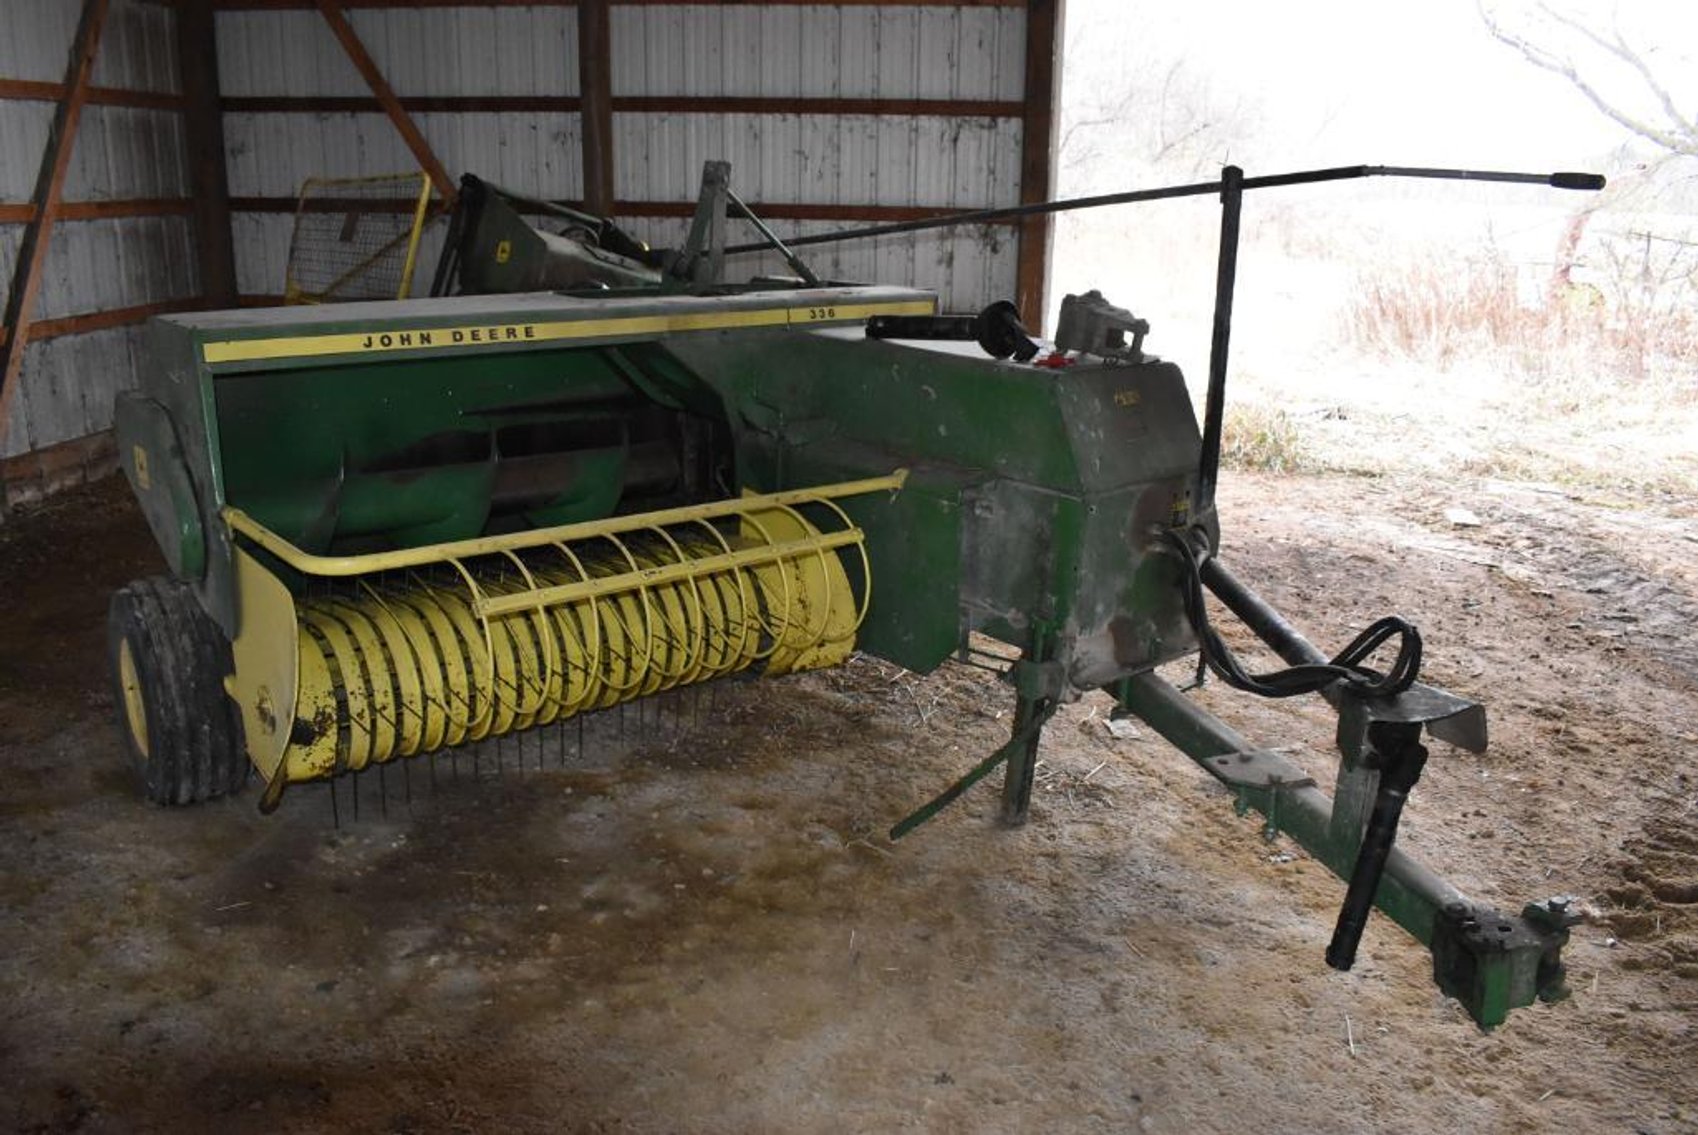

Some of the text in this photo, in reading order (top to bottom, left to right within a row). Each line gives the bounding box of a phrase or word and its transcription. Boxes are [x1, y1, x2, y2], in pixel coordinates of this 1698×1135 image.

[810, 308, 835, 319] 336
[362, 326, 535, 348] JOHN DEERE
